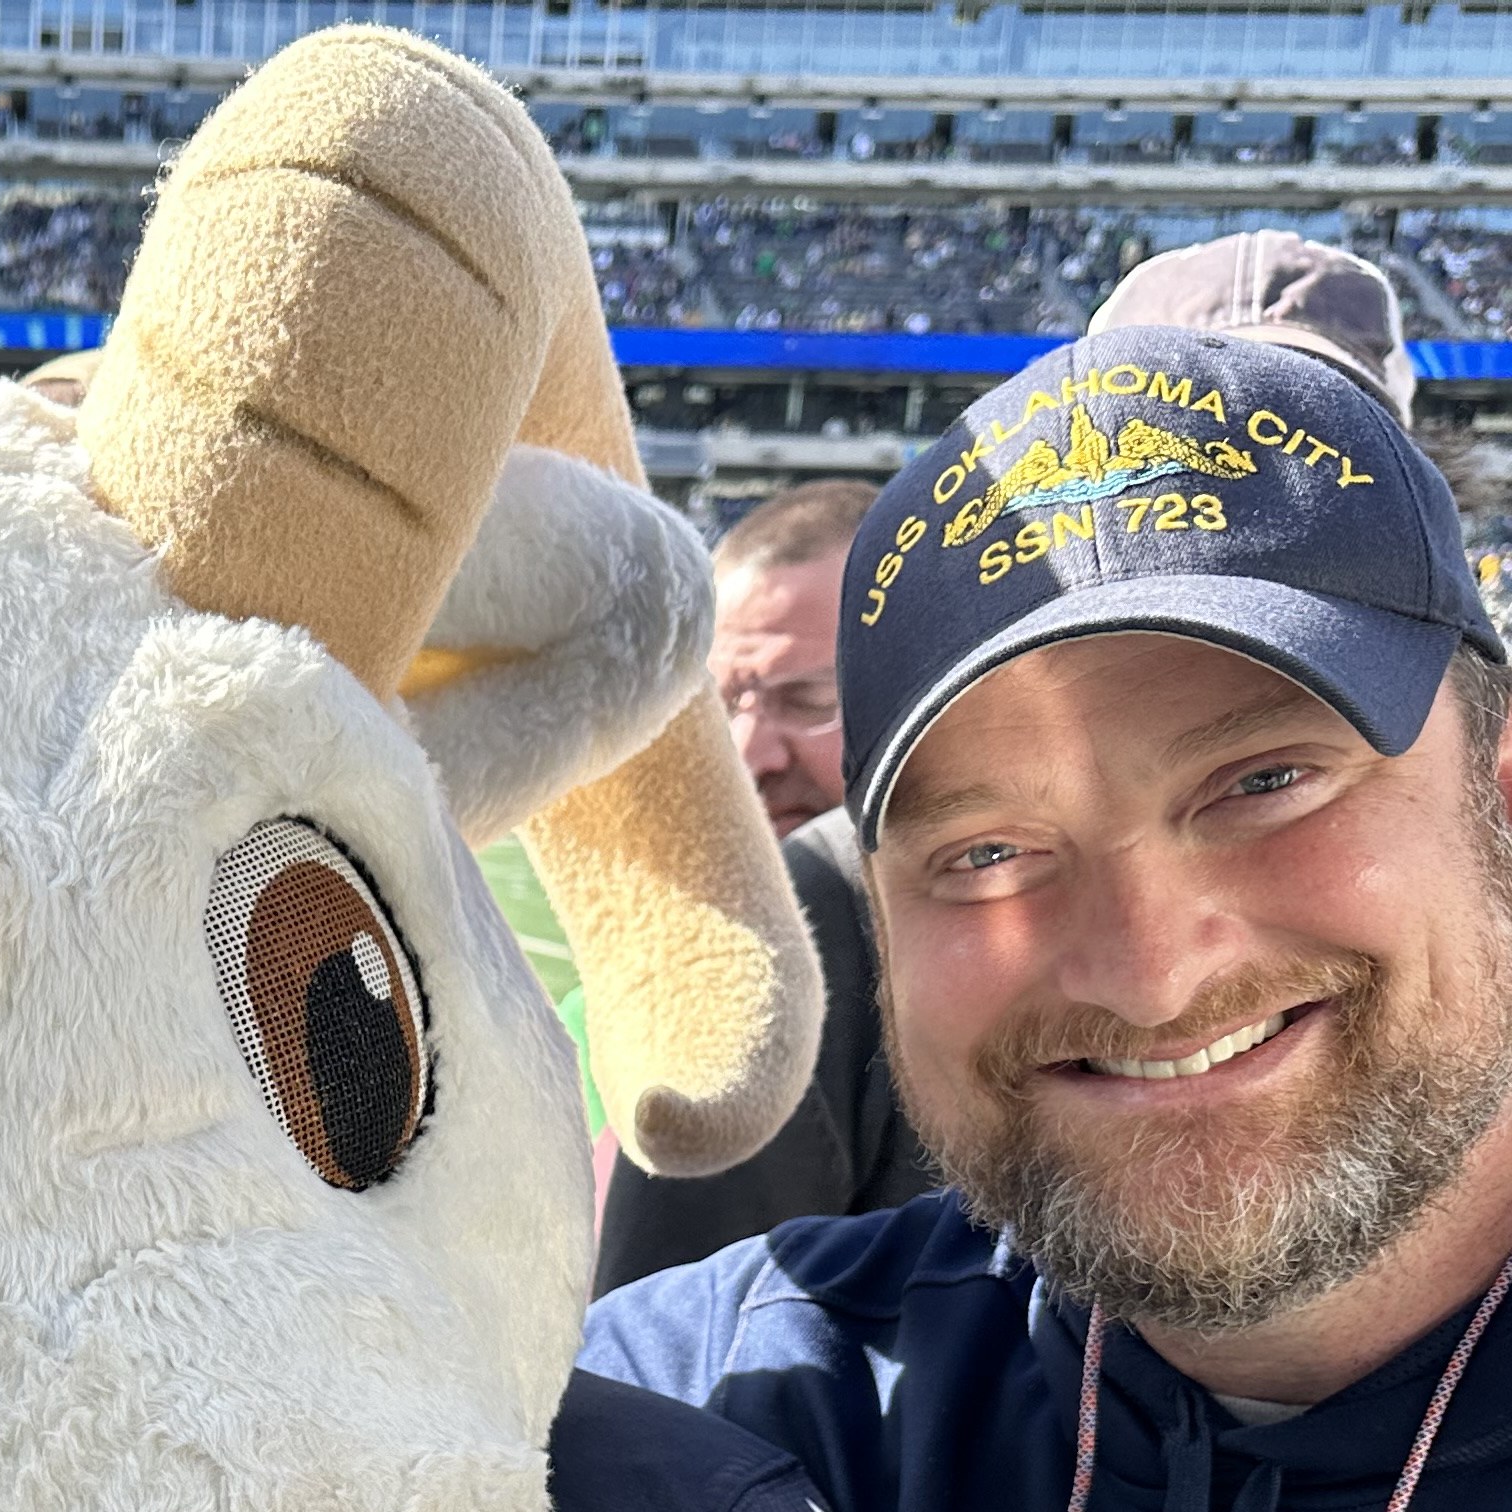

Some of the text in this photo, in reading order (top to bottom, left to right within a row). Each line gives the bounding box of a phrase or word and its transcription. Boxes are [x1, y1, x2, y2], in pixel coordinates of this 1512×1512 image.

[859, 363, 1375, 627] USS OKLAHOMA CITY
[978, 492, 1228, 586] SSN 723
